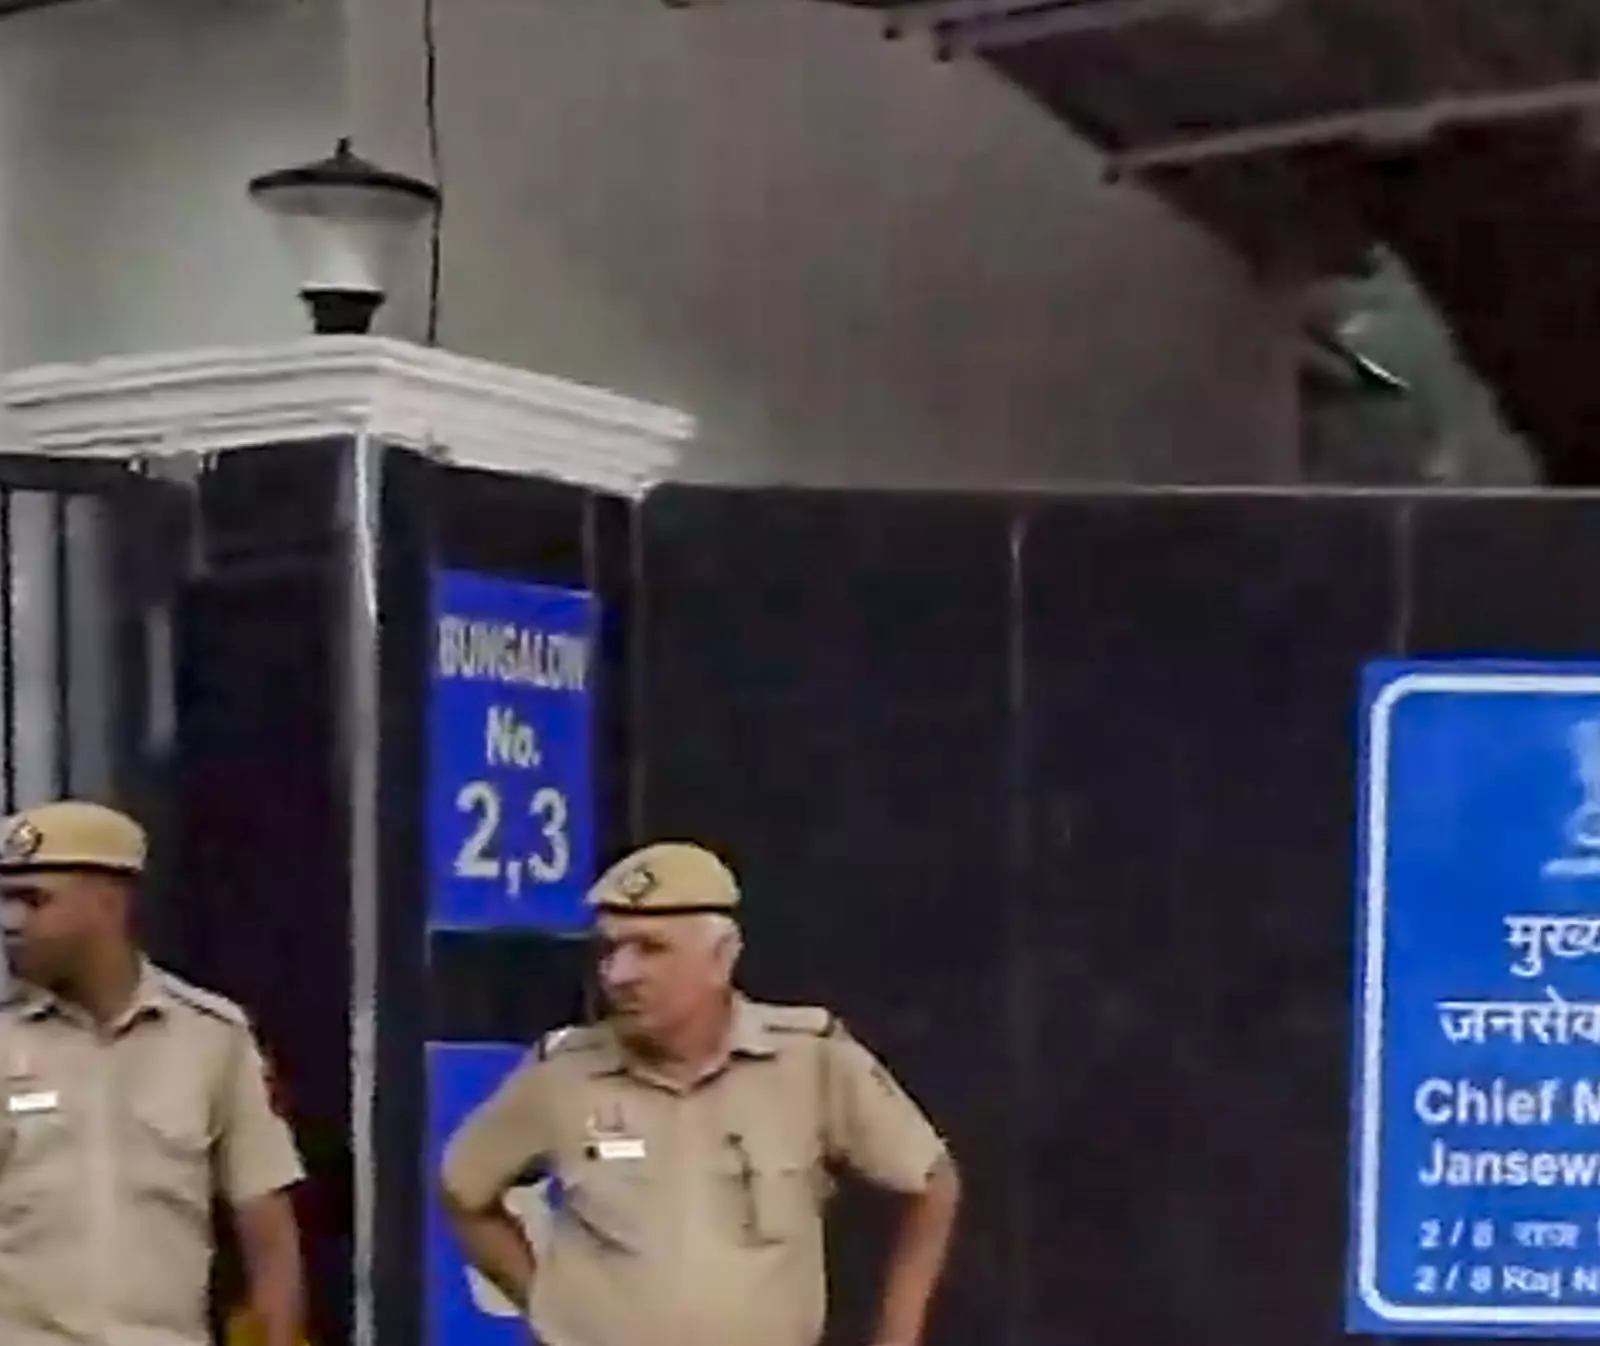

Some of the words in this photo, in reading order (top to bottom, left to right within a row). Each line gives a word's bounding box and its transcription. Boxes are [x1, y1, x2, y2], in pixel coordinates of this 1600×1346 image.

[439, 616, 587, 691] BUNGALOW
[486, 704, 542, 769] No.
[454, 780, 572, 896] 2,3
[1414, 1075, 1560, 1126] Chief
[1418, 1218, 1442, 1249] 2
[1414, 1264, 1438, 1294] 2
[1502, 1264, 1561, 1299] Raj
